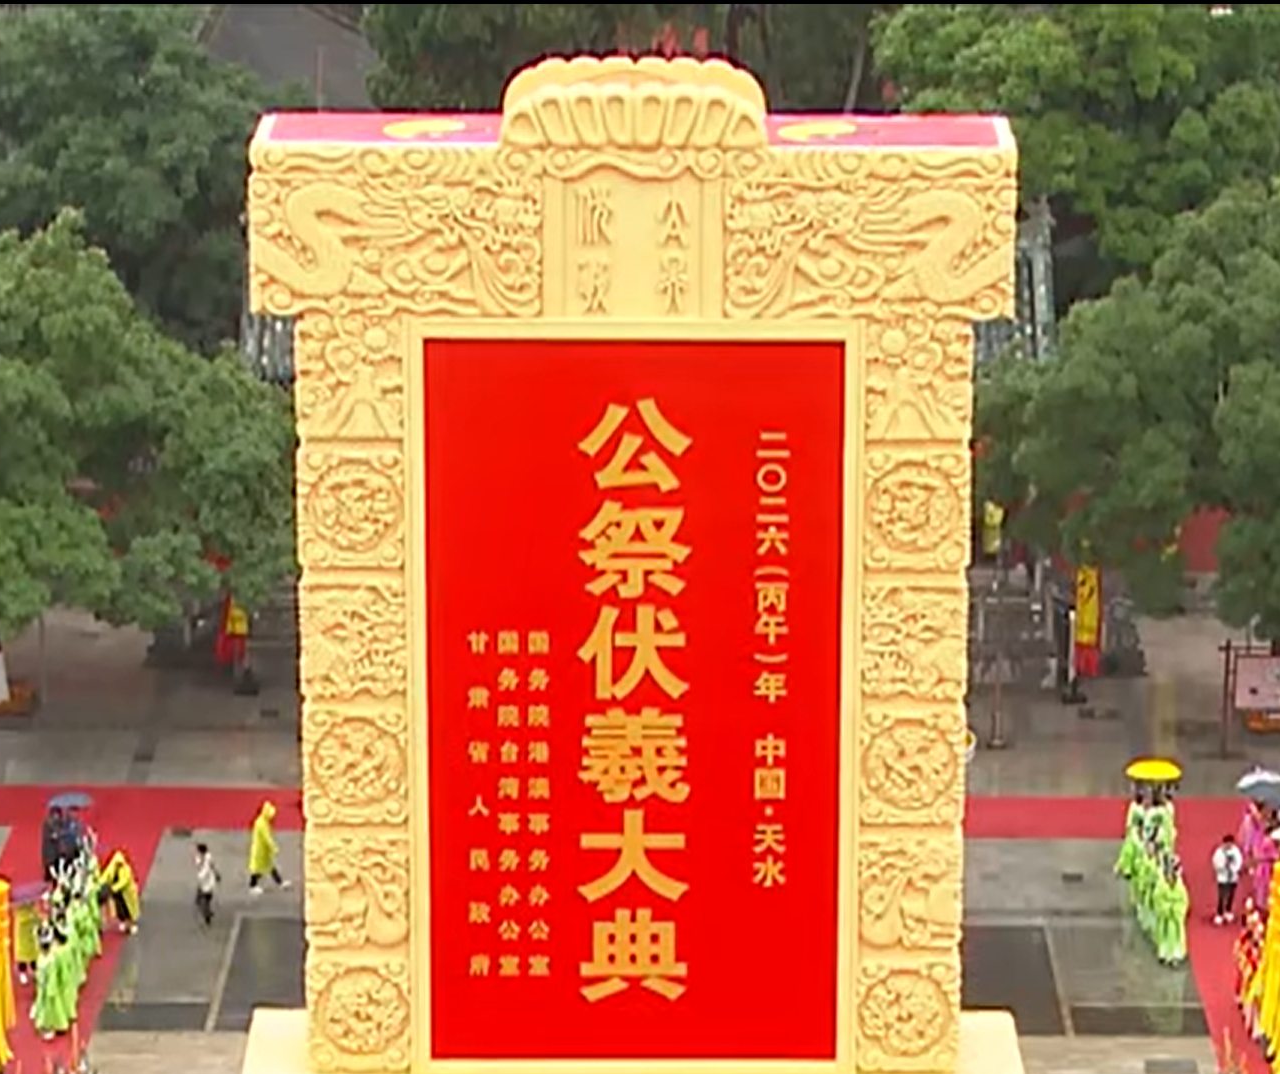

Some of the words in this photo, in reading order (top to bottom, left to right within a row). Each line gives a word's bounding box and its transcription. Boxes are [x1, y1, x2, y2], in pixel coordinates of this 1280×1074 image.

[467, 630, 491, 977] 甘肃省人民政府
[576, 397, 694, 1003] 公祭伏羲大典
